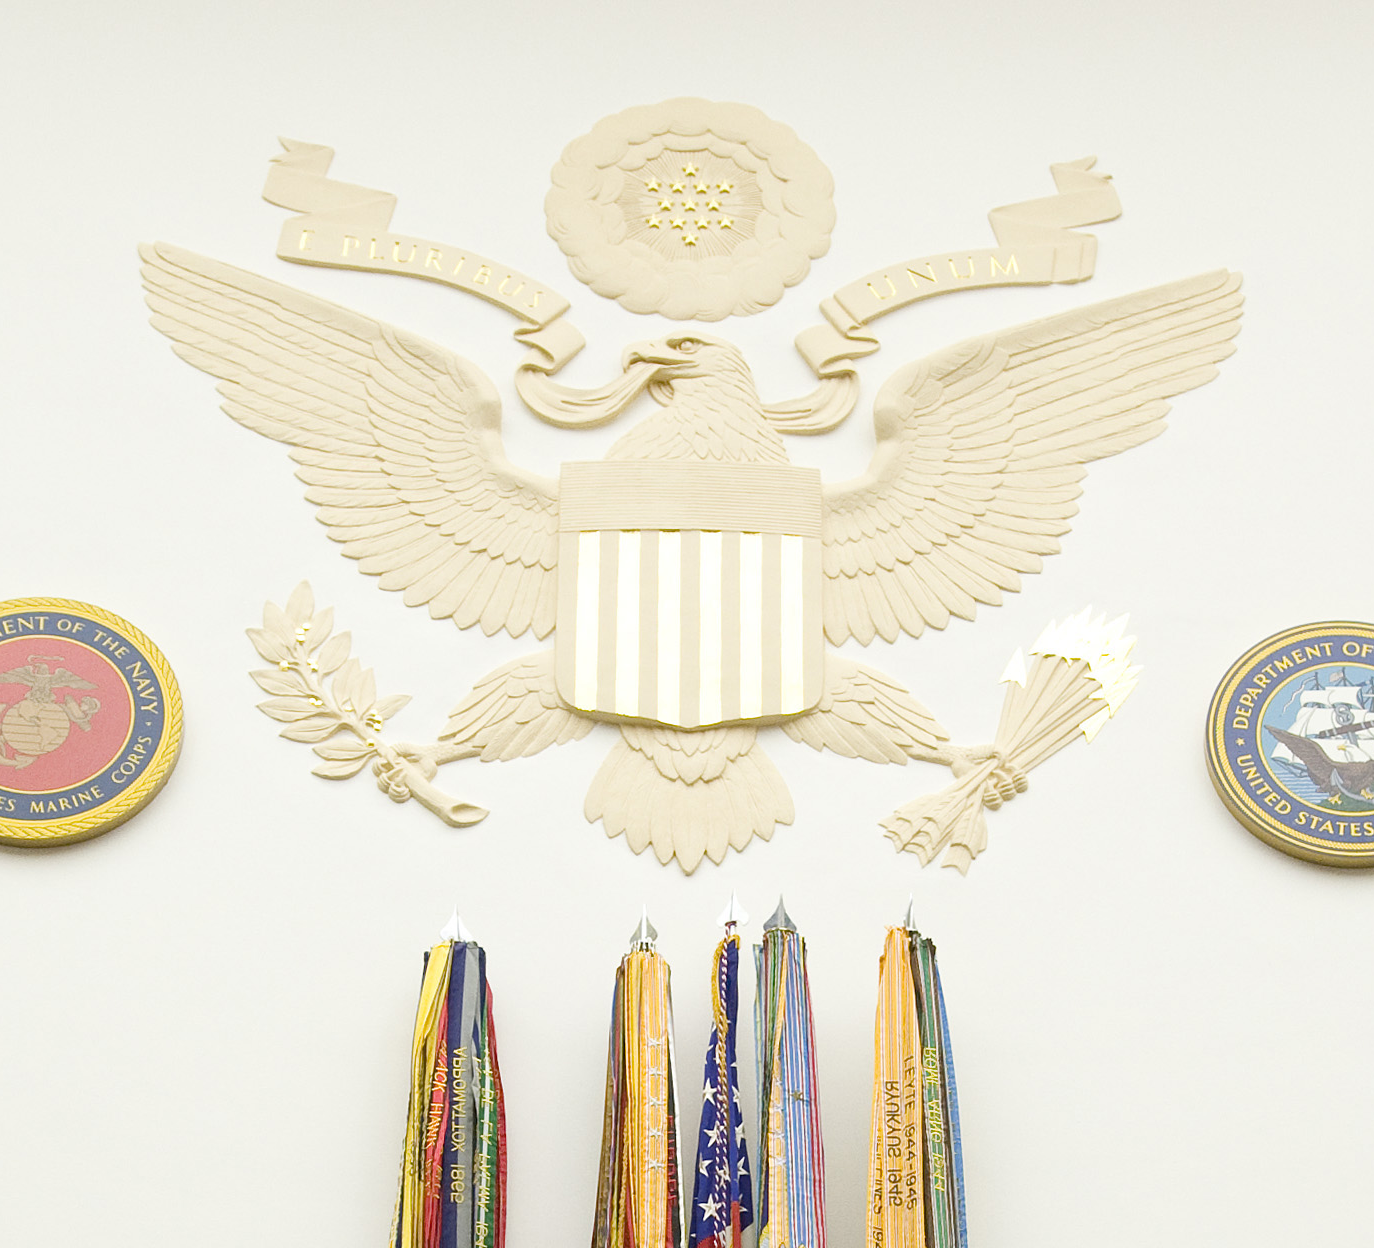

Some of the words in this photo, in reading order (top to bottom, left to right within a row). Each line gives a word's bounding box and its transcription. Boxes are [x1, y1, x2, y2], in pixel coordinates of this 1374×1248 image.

[298, 229, 317, 253] E
[340, 235, 546, 310] PLURIBUS
[866, 253, 1021, 301] UNUM
[57, 618, 85, 634] OF
[93, 629, 130, 660] THE
[125, 661, 158, 715] NAVY
[1232, 642, 1333, 730] DEPARTMENT
[1341, 640, 1374, 658] OF
[29, 785, 105, 814] MARINE
[111, 735, 152, 784] CORPS
[1235, 753, 1292, 816] UNITED
[1294, 810, 1374, 837] STATES
